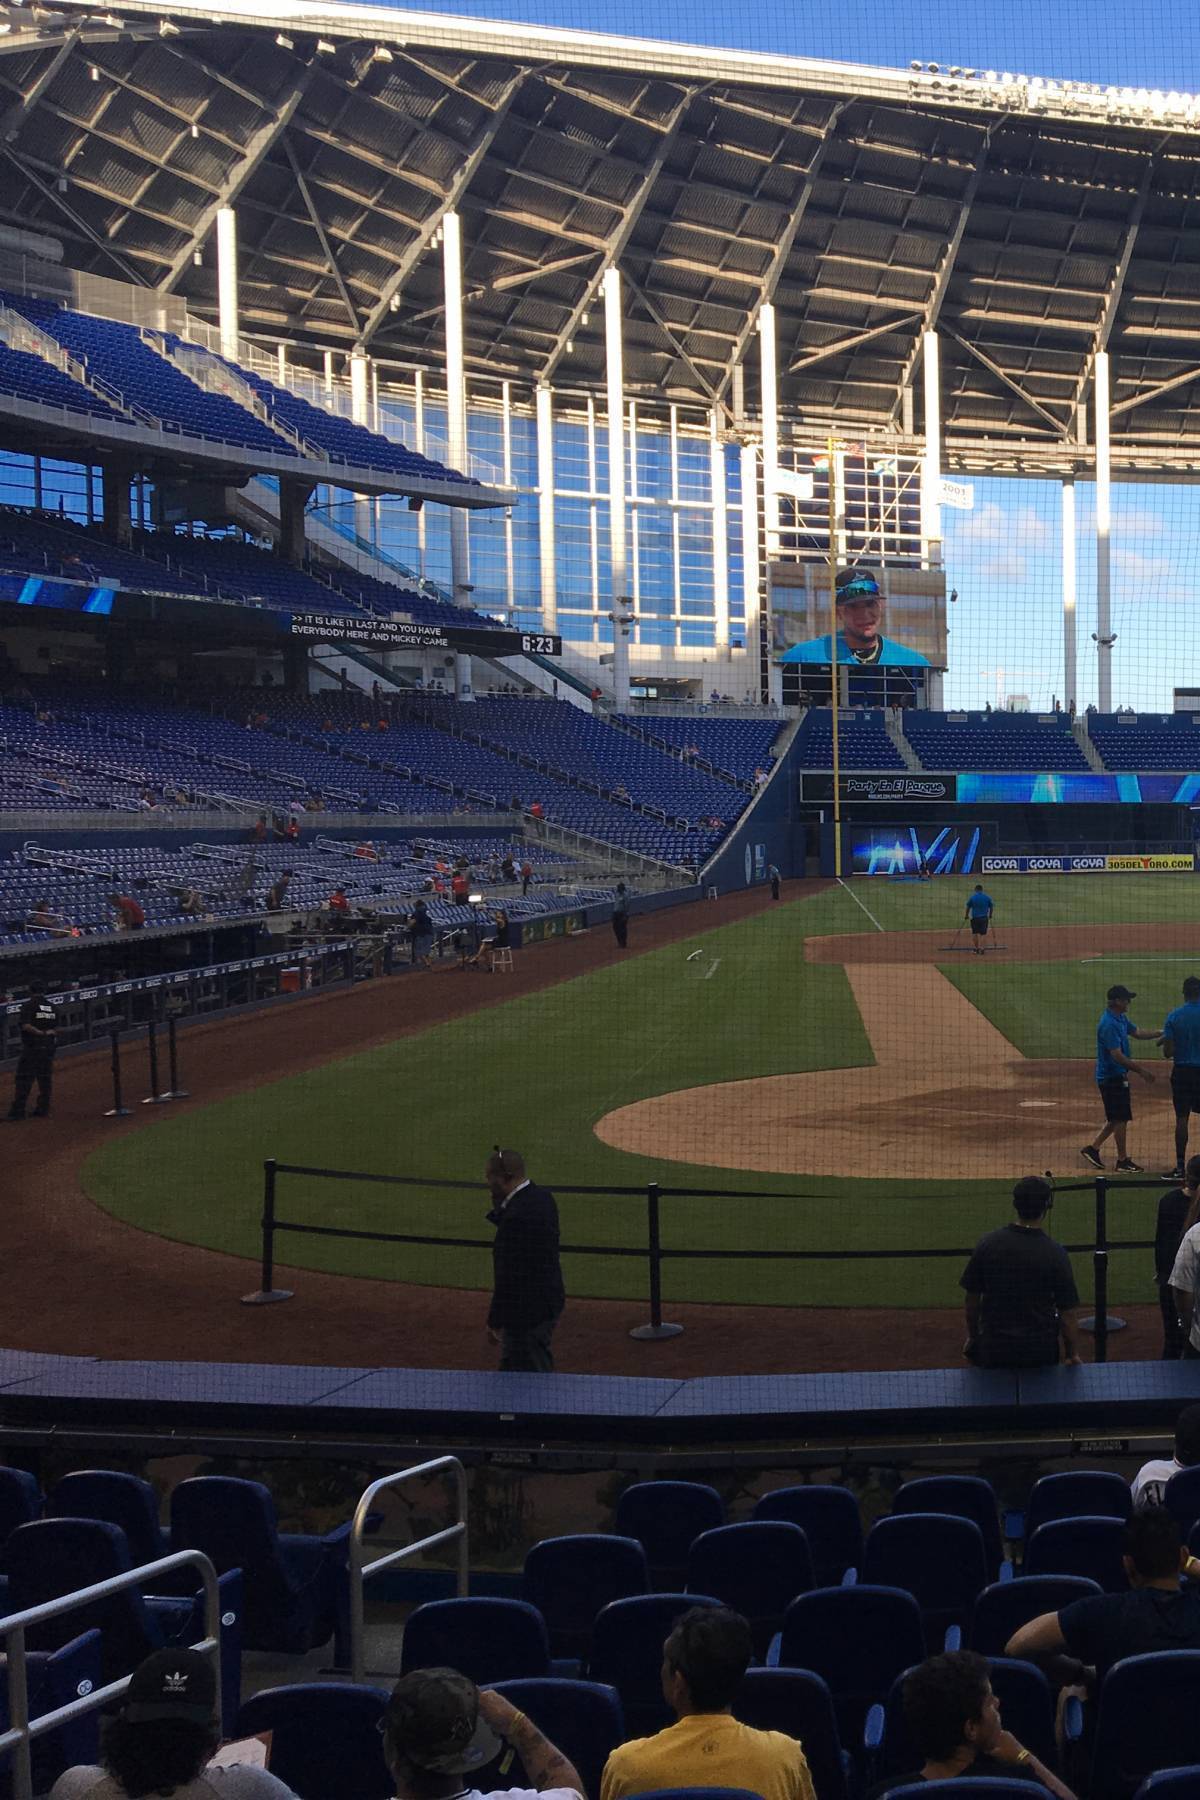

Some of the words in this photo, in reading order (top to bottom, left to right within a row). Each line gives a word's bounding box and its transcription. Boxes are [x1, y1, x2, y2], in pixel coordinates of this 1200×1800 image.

[305, 616, 313, 624] IT
[315, 616, 324, 625] IS
[325, 617, 344, 627] LIKE
[356, 620, 378, 629] LAST
[379, 622, 398, 632] AND
[399, 624, 417, 633] YOU
[418, 626, 441, 636] HAVE
[291, 625, 345, 638] EVERYBODY
[346, 631, 369, 640] HERE
[370, 632, 390, 642] AND
[391, 634, 425, 645] MICKEY
[424, 637, 448, 647] CAME
[522, 636, 553, 653] 6:23
[848, 779, 878, 793] Party
[878, 779, 892, 792] En
[892, 779, 905, 792] El
[905, 779, 945, 794] Parque
[985, 859, 1018, 870] GOYA
[1029, 858, 1061, 870] GOYA
[1072, 857, 1104, 869] GOYA
[79, 990, 98, 1000] GEICO
